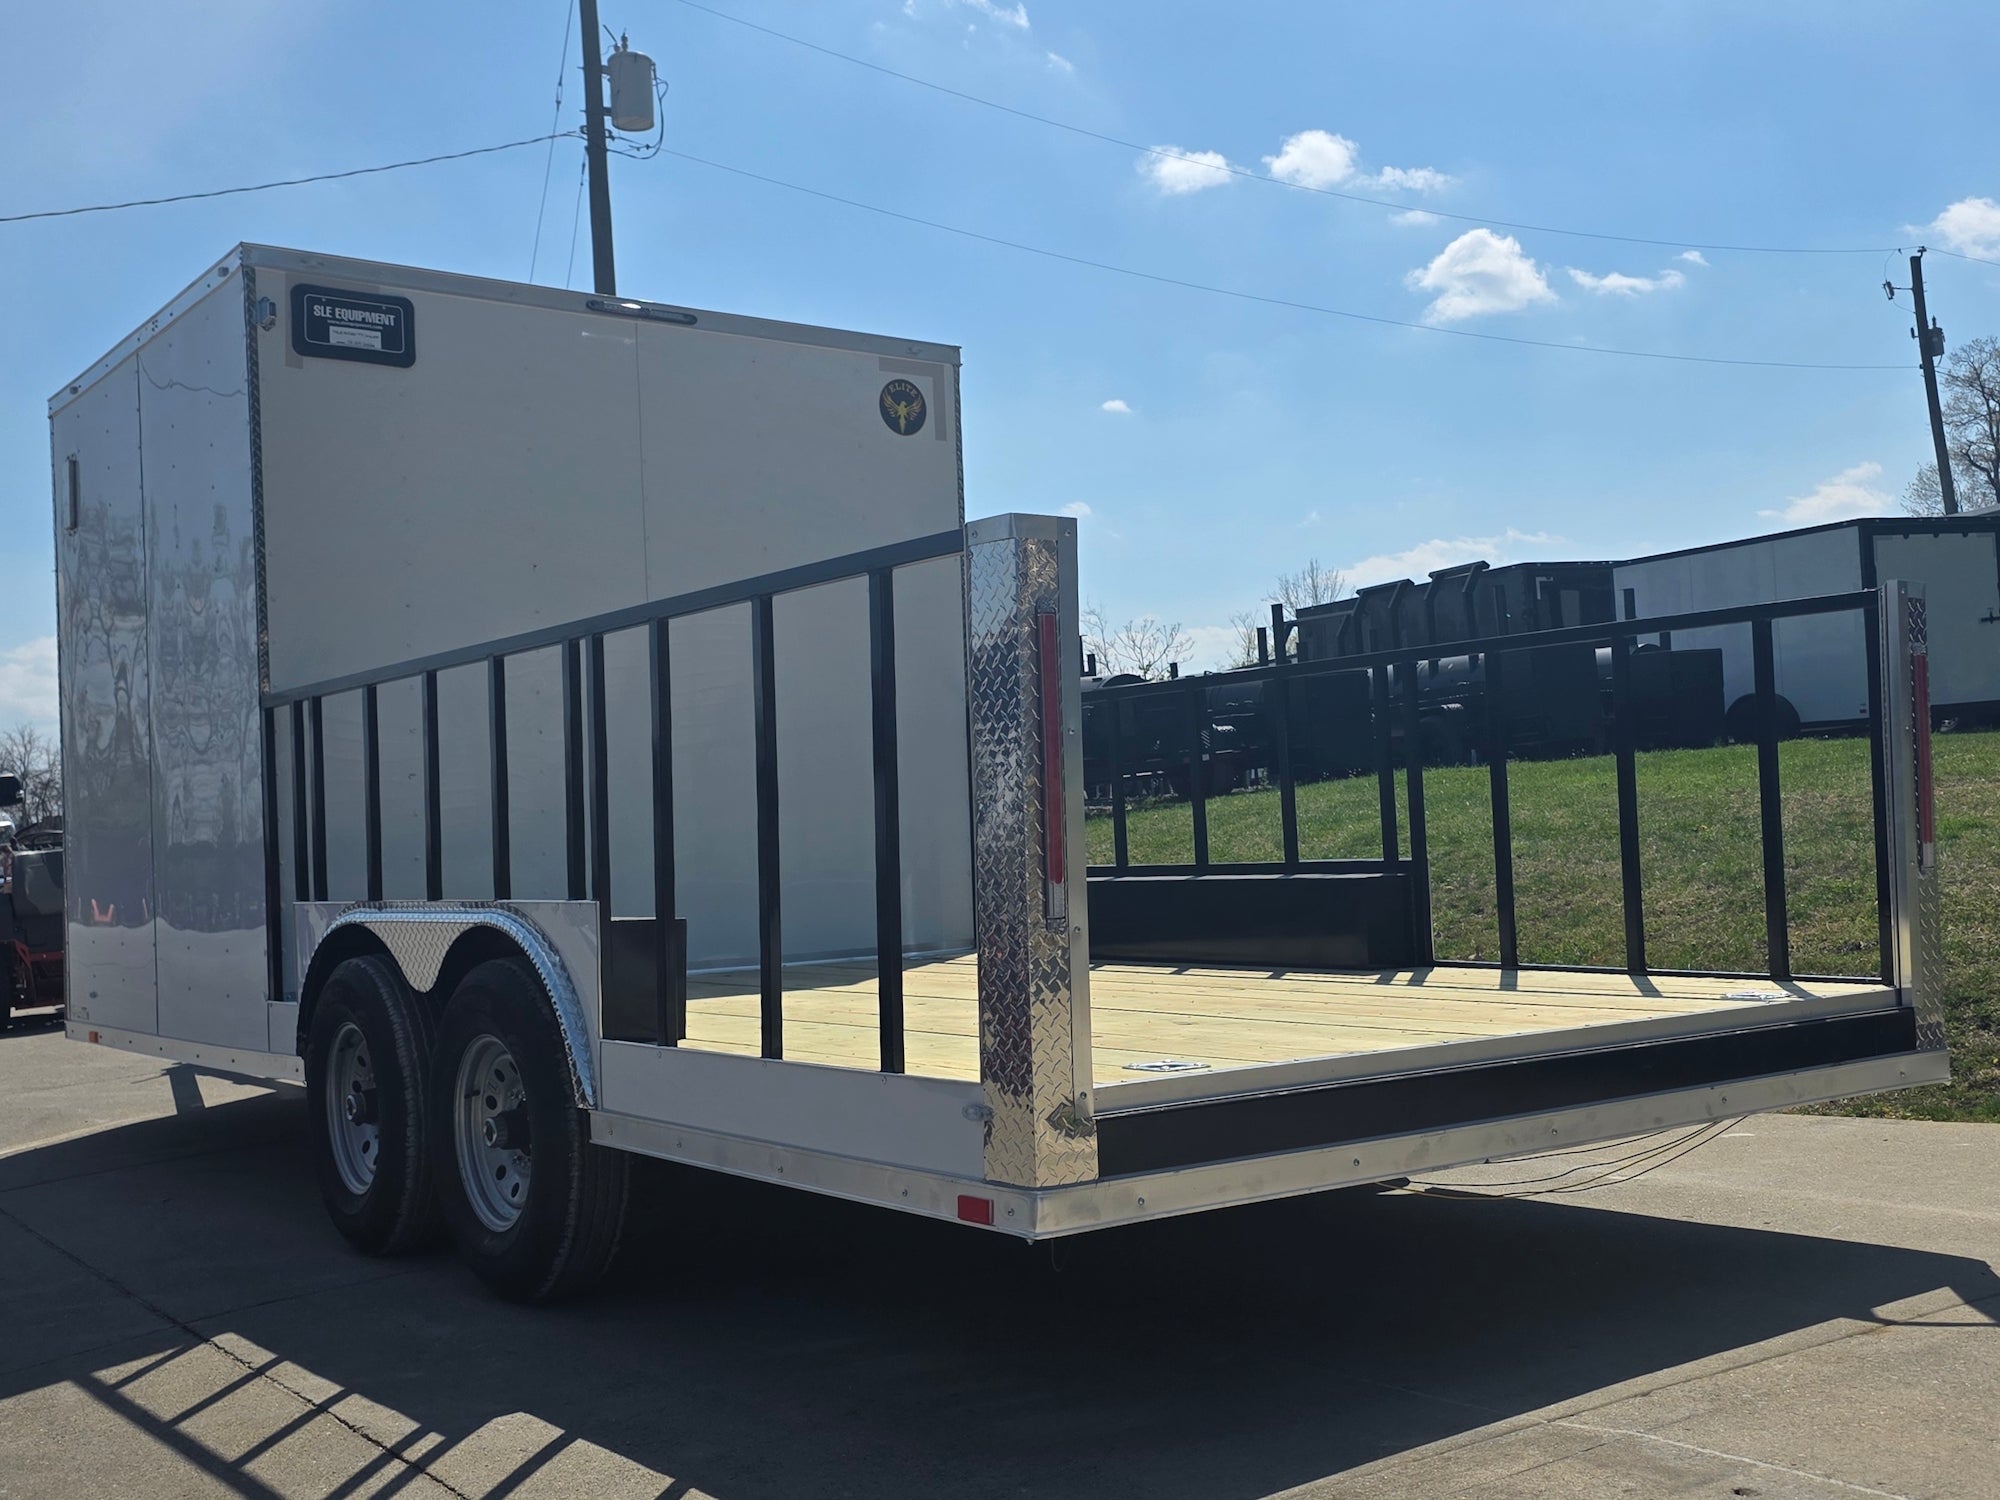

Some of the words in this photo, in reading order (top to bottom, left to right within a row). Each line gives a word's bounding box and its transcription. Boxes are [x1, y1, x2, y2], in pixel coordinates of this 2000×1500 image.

[313, 304, 333, 318] SLE
[335, 307, 396, 326] EQUIPMENT
[889, 383, 918, 397] ELITE
